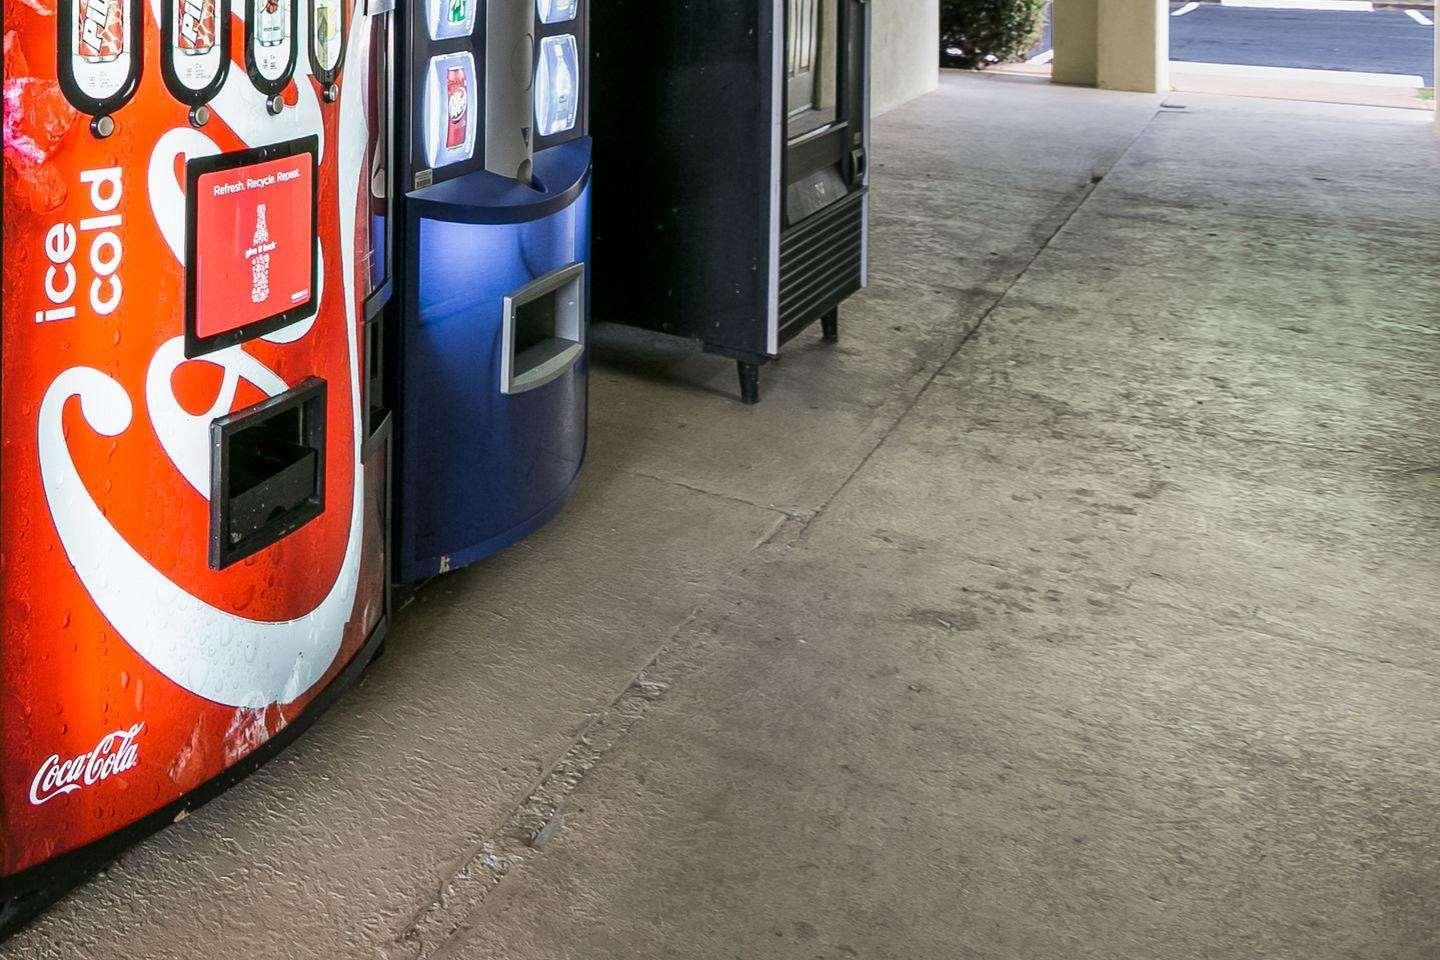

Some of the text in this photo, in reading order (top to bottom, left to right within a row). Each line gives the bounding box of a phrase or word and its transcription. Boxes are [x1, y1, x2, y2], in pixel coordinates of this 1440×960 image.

[213, 181, 245, 196] Refresh.
[35, 222, 77, 324] ice
[80, 166, 122, 315] cold
[29, 721, 145, 804] Coca-Cola
